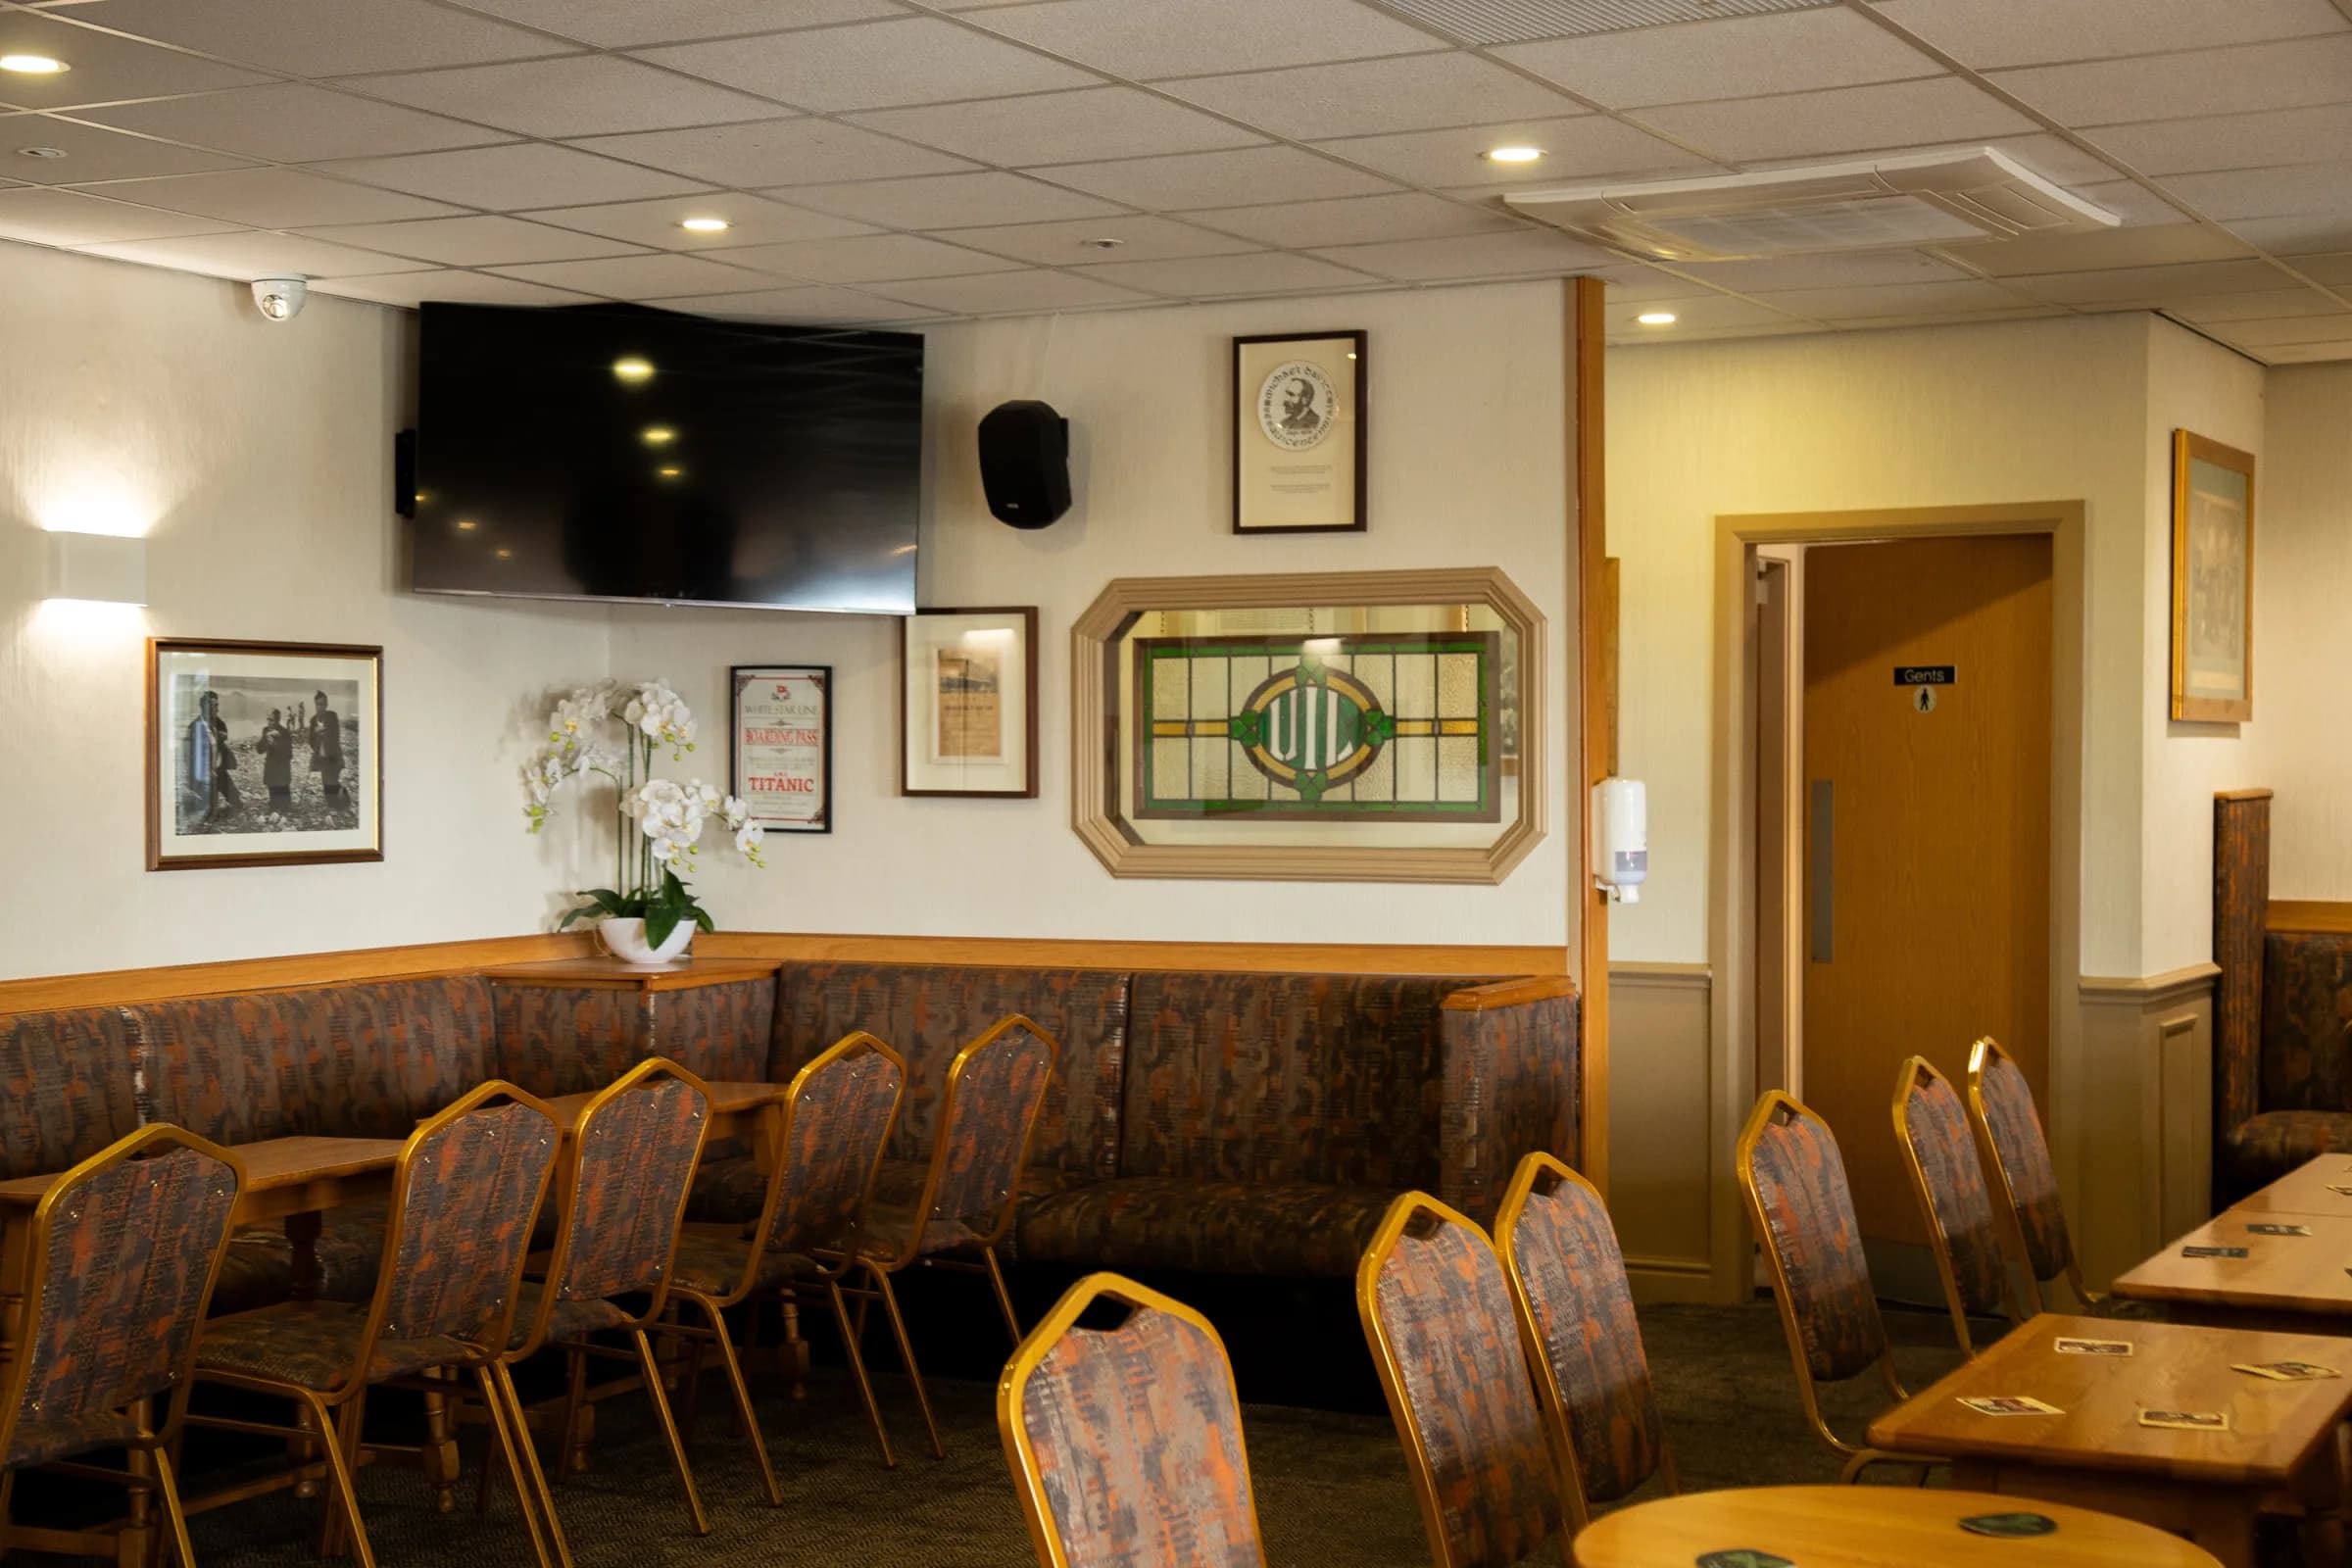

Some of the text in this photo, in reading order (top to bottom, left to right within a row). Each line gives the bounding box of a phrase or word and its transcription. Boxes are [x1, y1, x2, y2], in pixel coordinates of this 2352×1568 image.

[1904, 668, 1945, 683] Gents
[746, 728, 816, 746] BOARDING PASS
[748, 776, 814, 793] TITANIC
